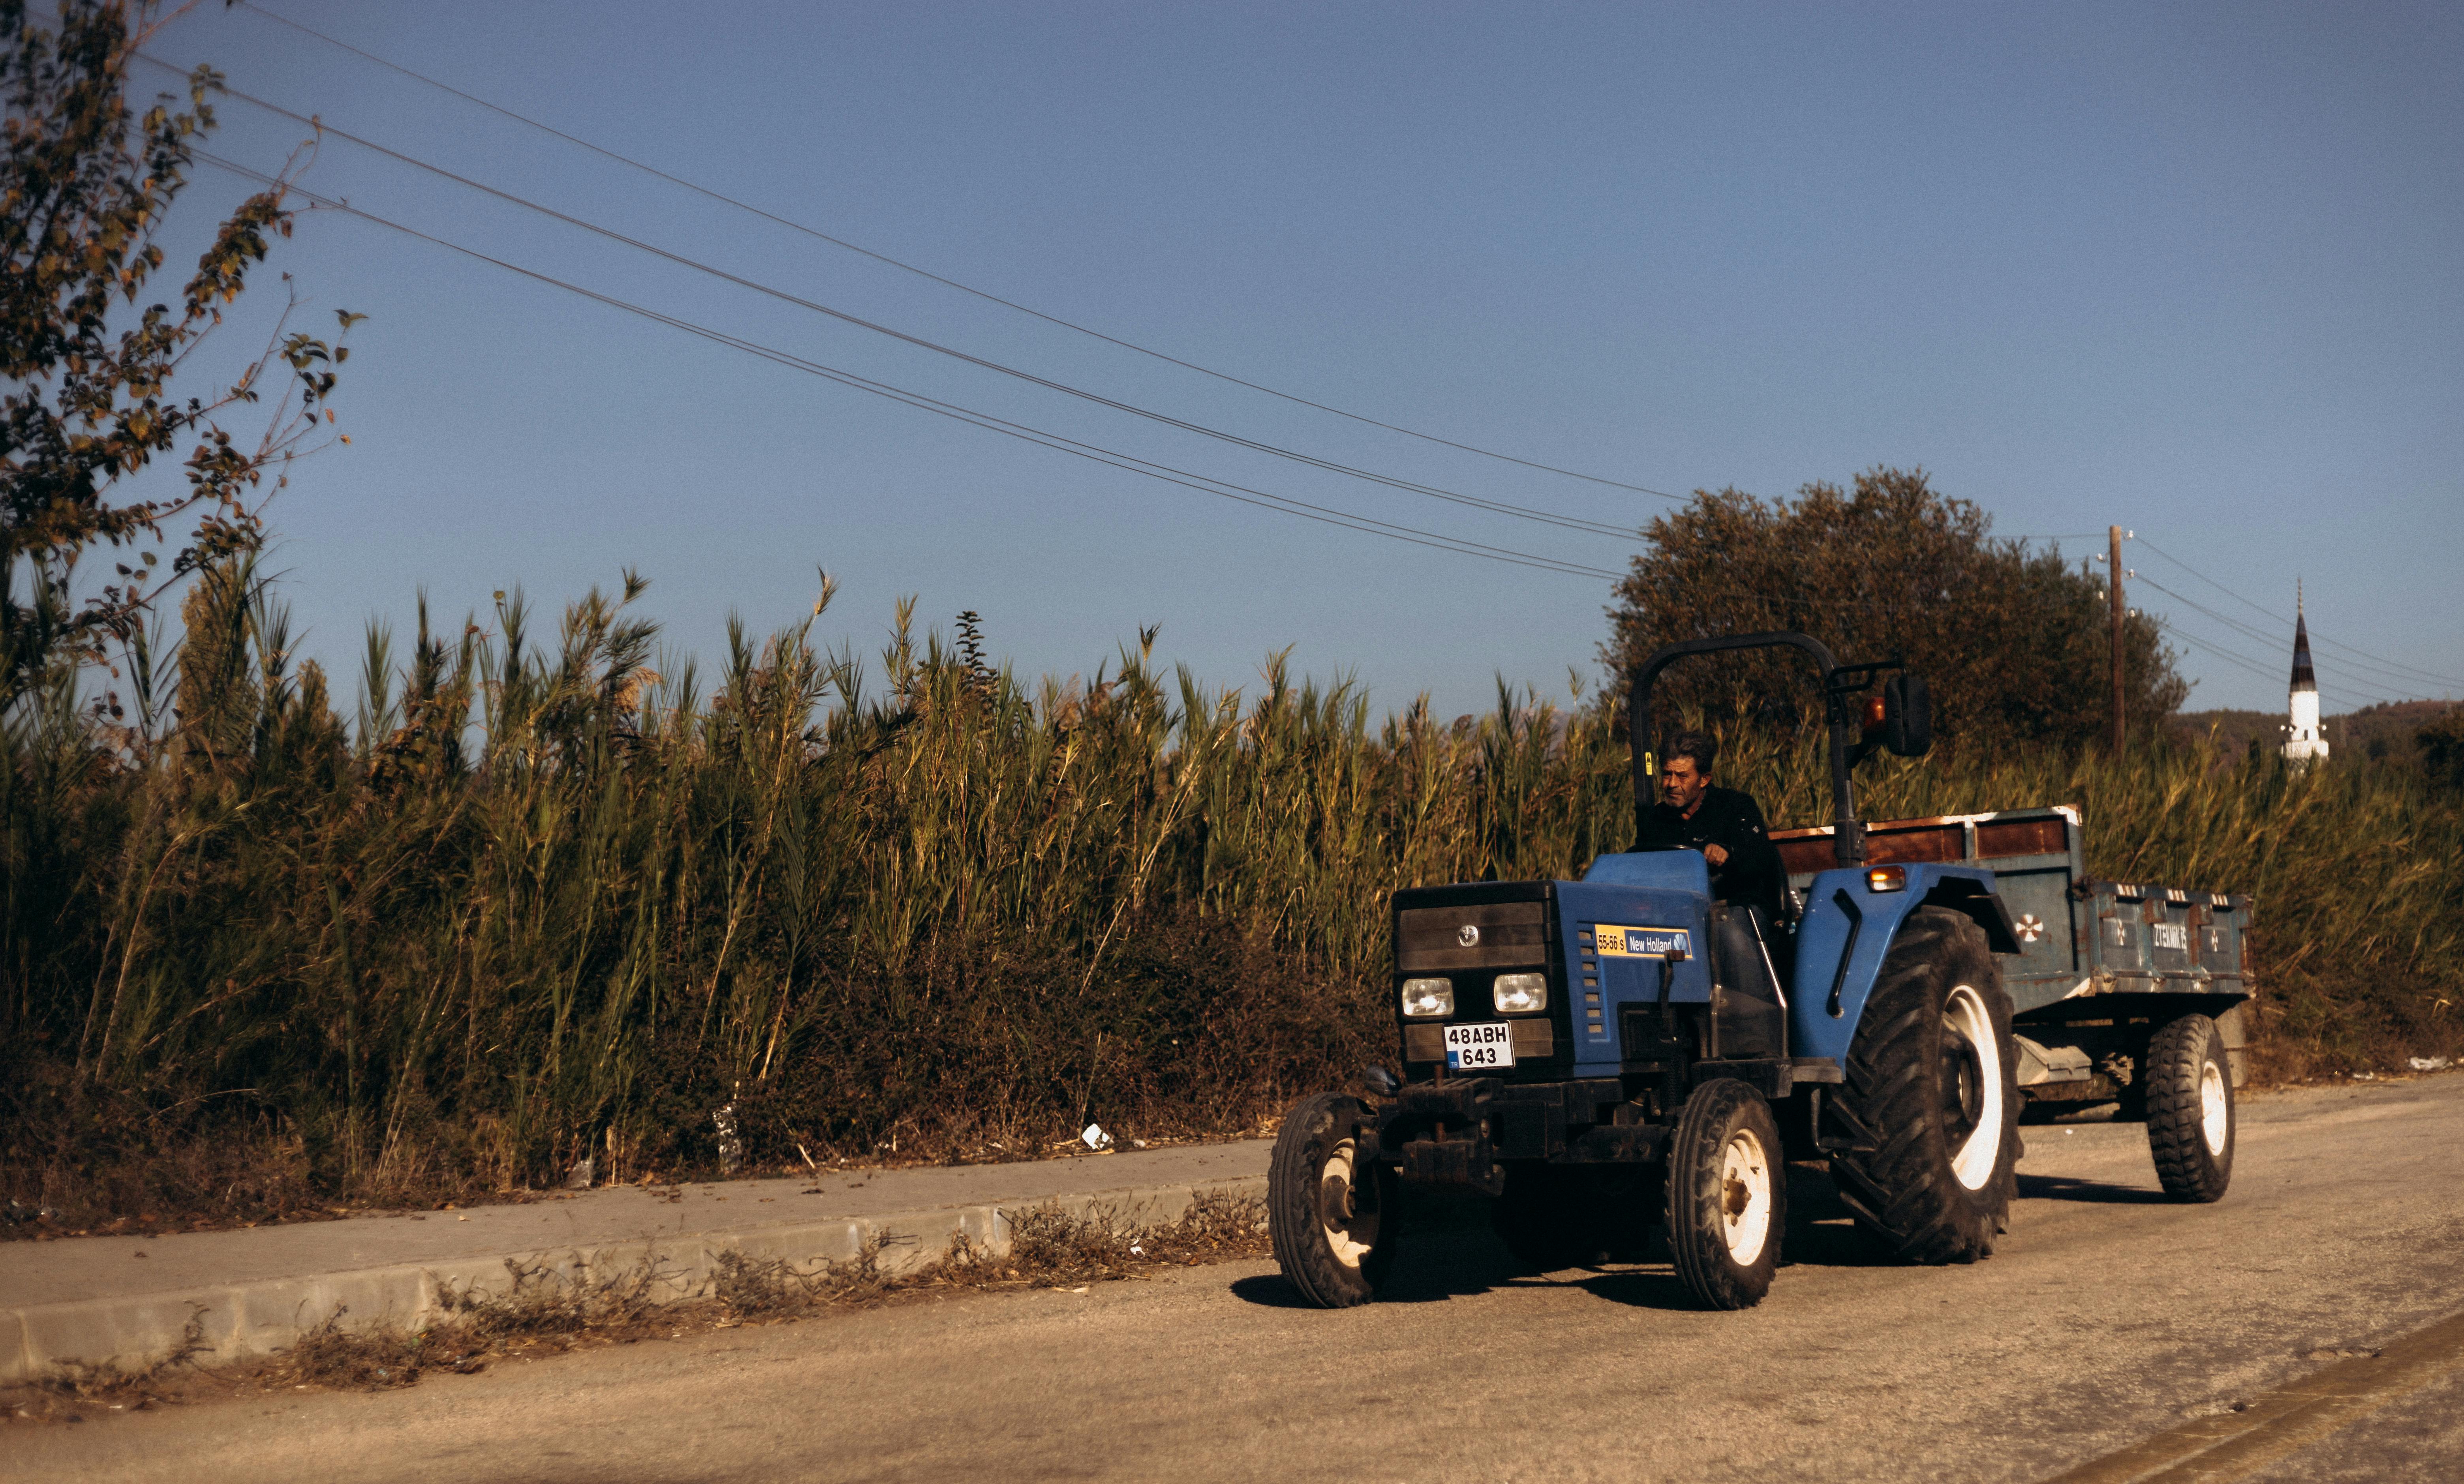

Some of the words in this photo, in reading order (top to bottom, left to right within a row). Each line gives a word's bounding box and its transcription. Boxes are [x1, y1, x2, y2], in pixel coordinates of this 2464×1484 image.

[1598, 934, 1618, 949] 55-56
[1629, 936, 1645, 951] New
[1646, 937, 1672, 952] Holland
[1449, 1026, 1506, 1044] 48ABH
[1463, 1048, 1497, 1065] 643
